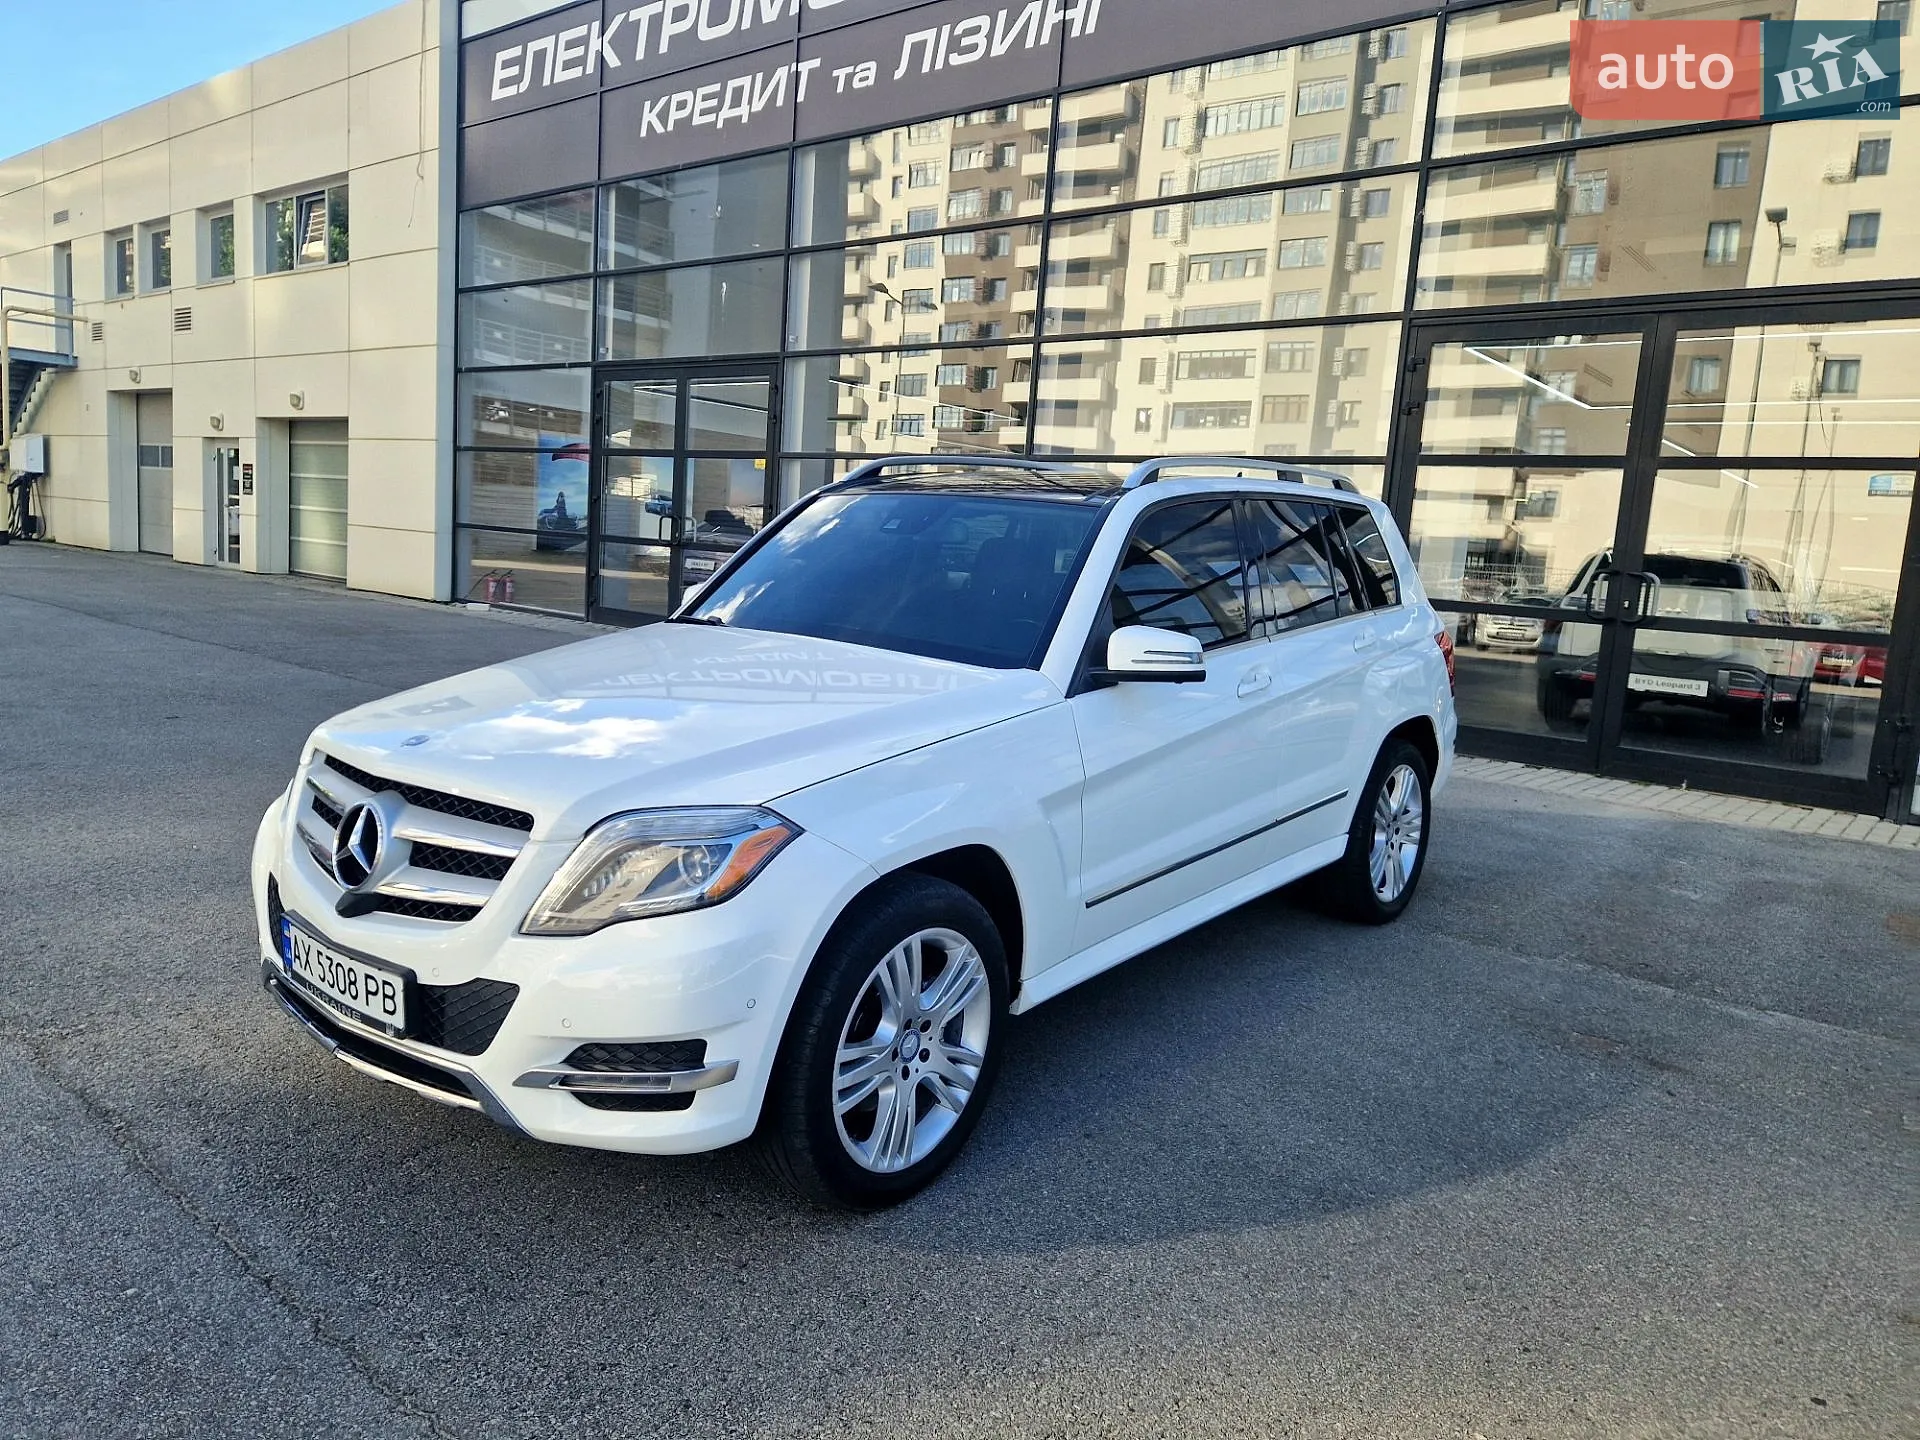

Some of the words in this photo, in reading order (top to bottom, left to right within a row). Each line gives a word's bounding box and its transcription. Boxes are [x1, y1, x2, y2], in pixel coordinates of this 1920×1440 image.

[491, 0, 851, 102] ЕЛЕКТРО
[640, 57, 821, 137] КРЕДИТ
[832, 60, 878, 94] та
[293, 934, 314, 977] AX
[316, 949, 359, 1001] 5308
[364, 972, 397, 1016] PB
